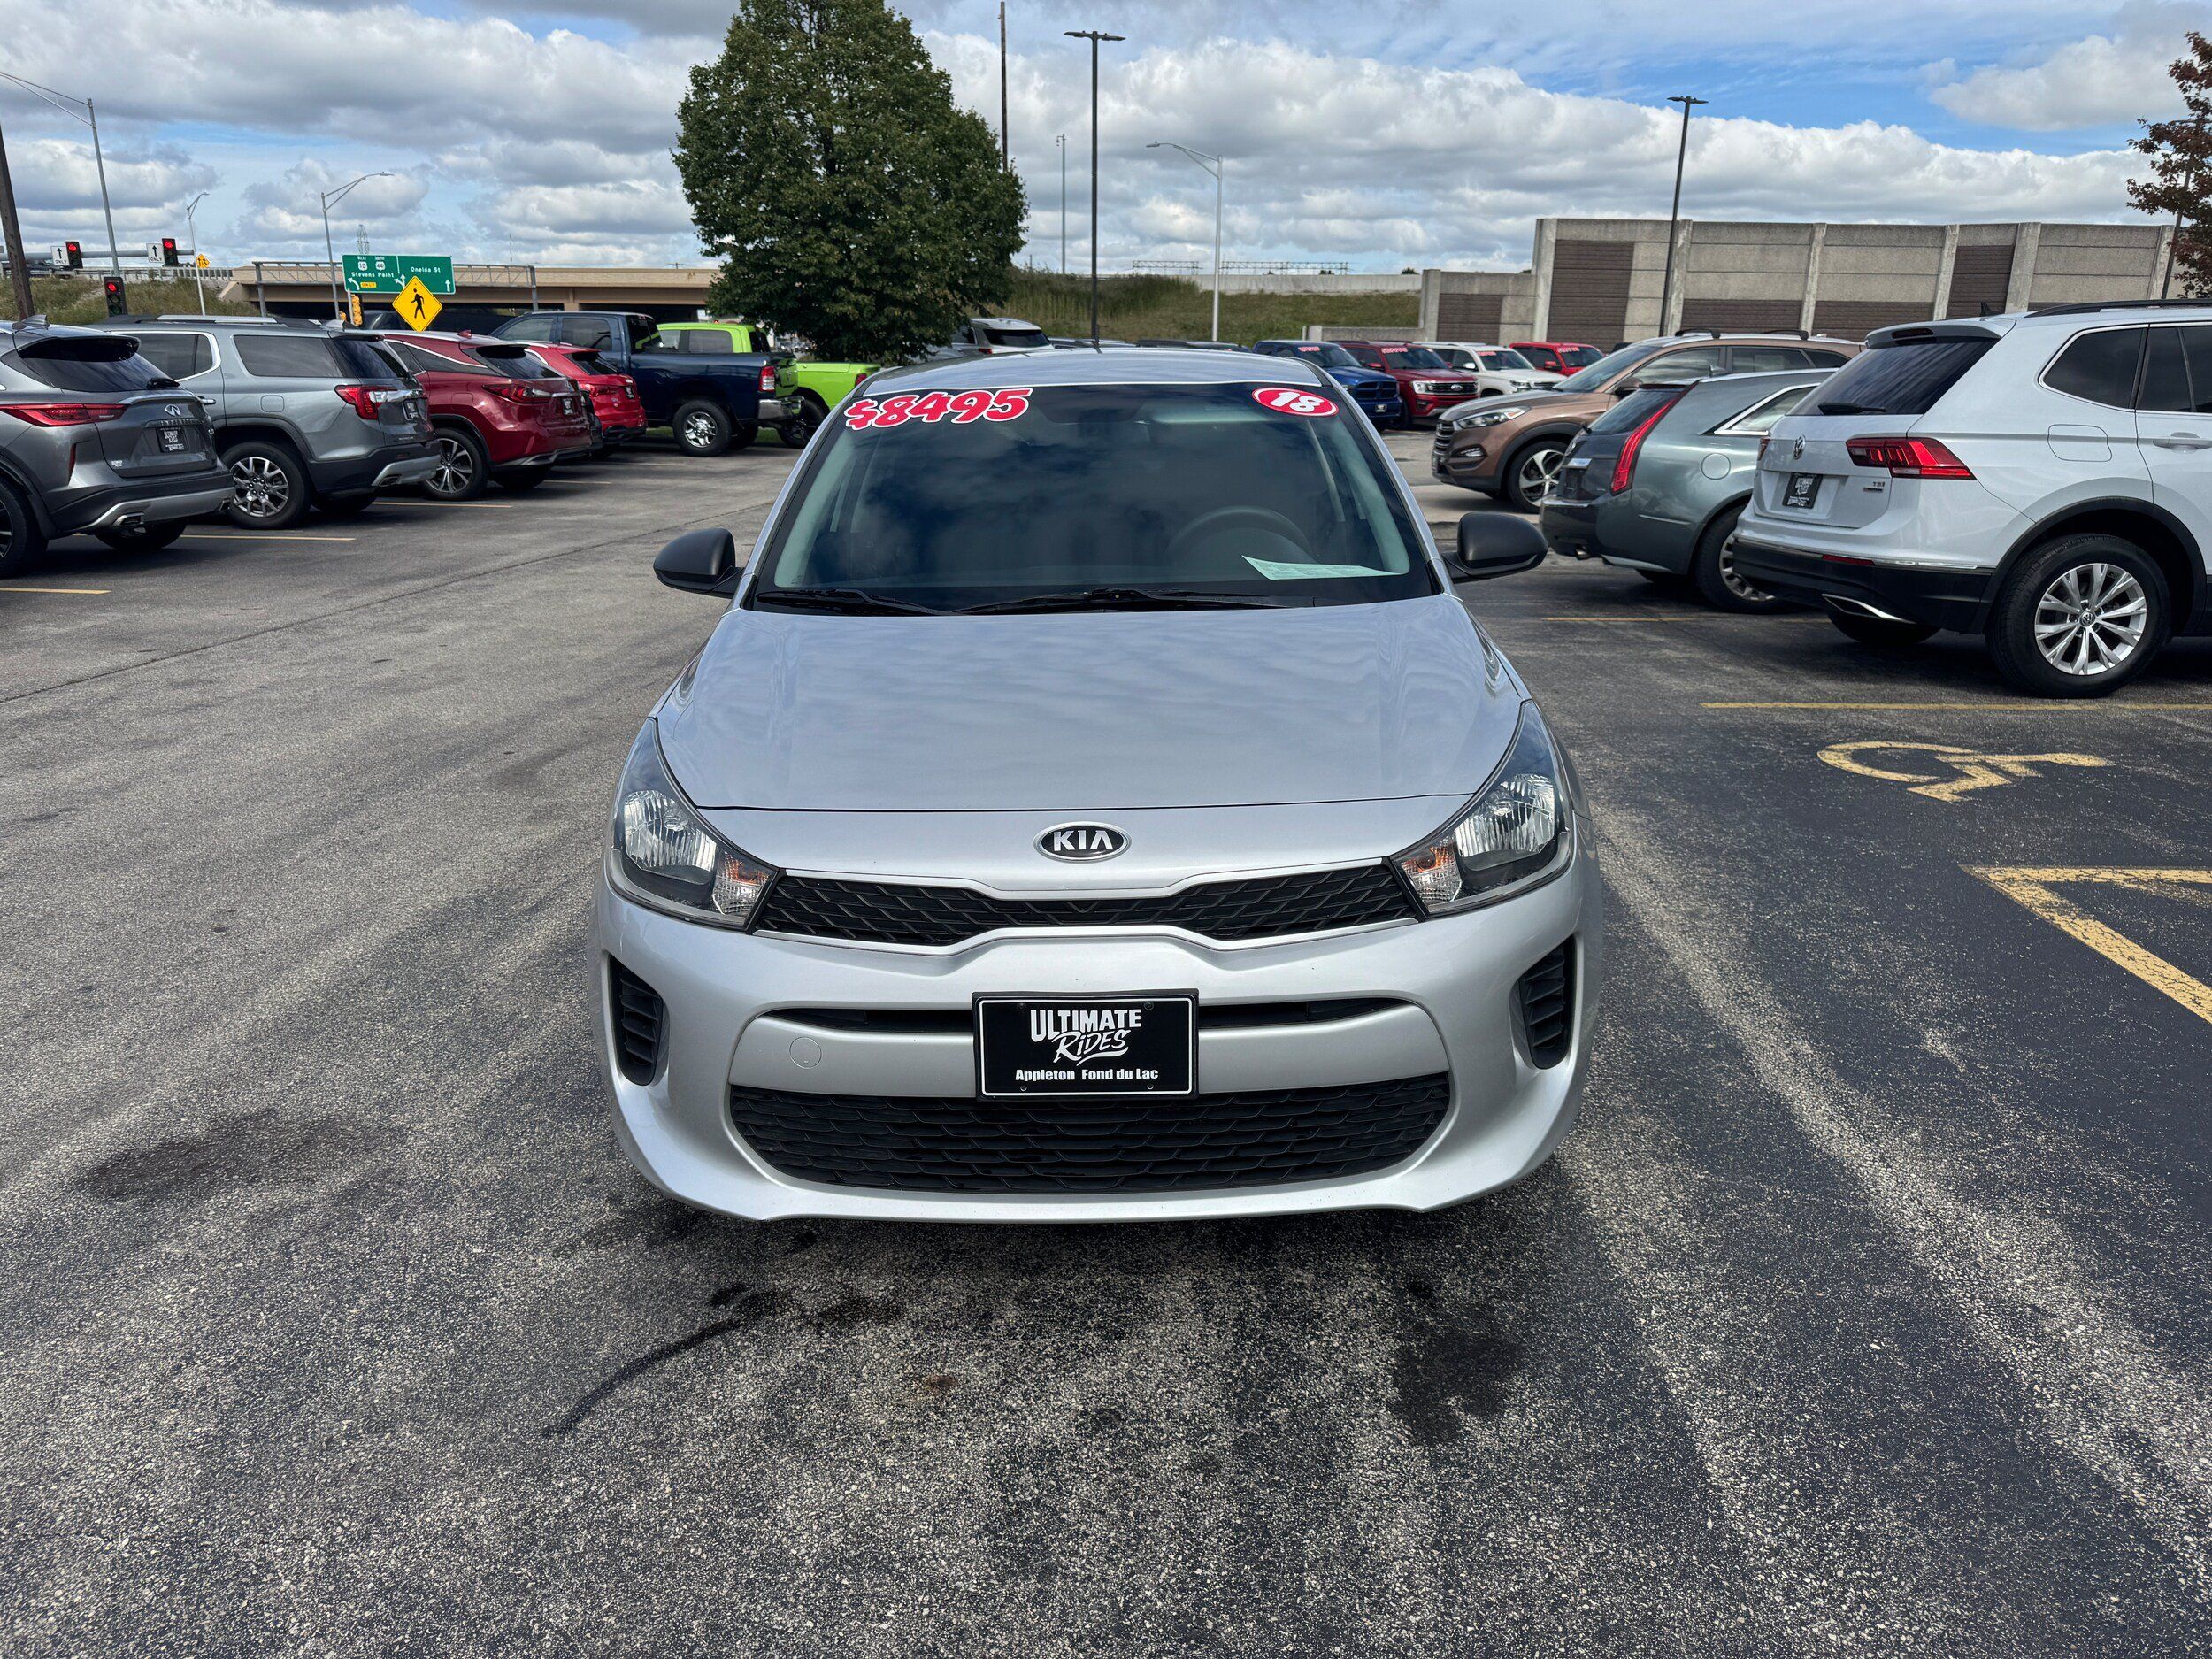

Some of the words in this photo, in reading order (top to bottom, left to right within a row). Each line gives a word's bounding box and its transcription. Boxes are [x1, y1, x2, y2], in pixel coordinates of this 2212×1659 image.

[844, 388, 1033, 431] $8495
[1270, 391, 1325, 412] 18
[1053, 830, 1114, 851] KIA
[1030, 1009, 1141, 1042] ULTIMATE
[1015, 1069, 1075, 1082] Appleton
[1081, 1069, 1113, 1080] Fond
[1116, 1069, 1133, 1080] du
[1136, 1069, 1158, 1080] Lac
